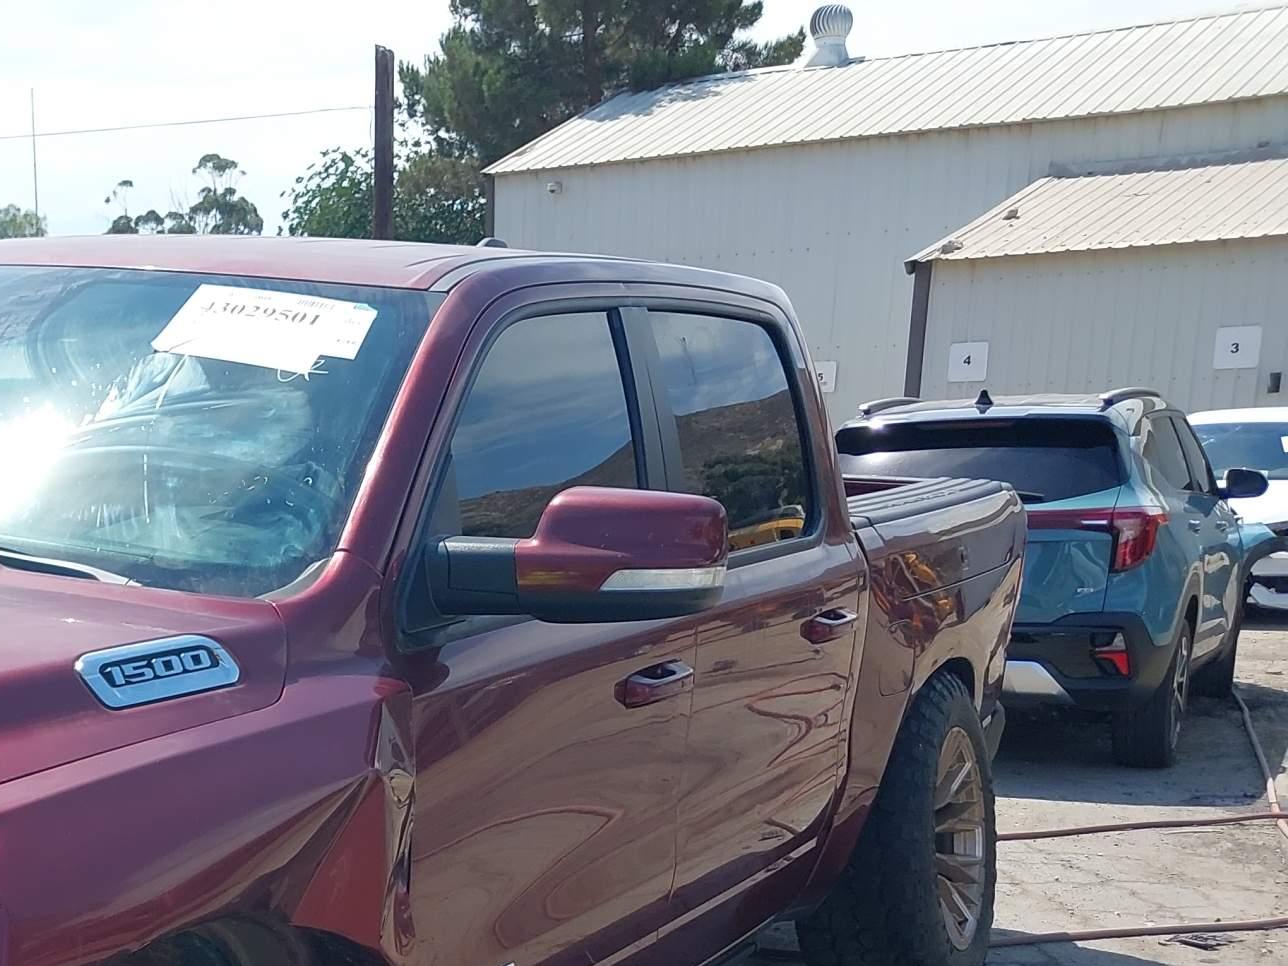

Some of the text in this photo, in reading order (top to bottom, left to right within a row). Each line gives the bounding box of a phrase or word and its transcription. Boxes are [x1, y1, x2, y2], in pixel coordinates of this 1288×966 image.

[1230, 342, 1240, 354] 3
[963, 355, 972, 366] 4
[103, 649, 212, 686] 1500
